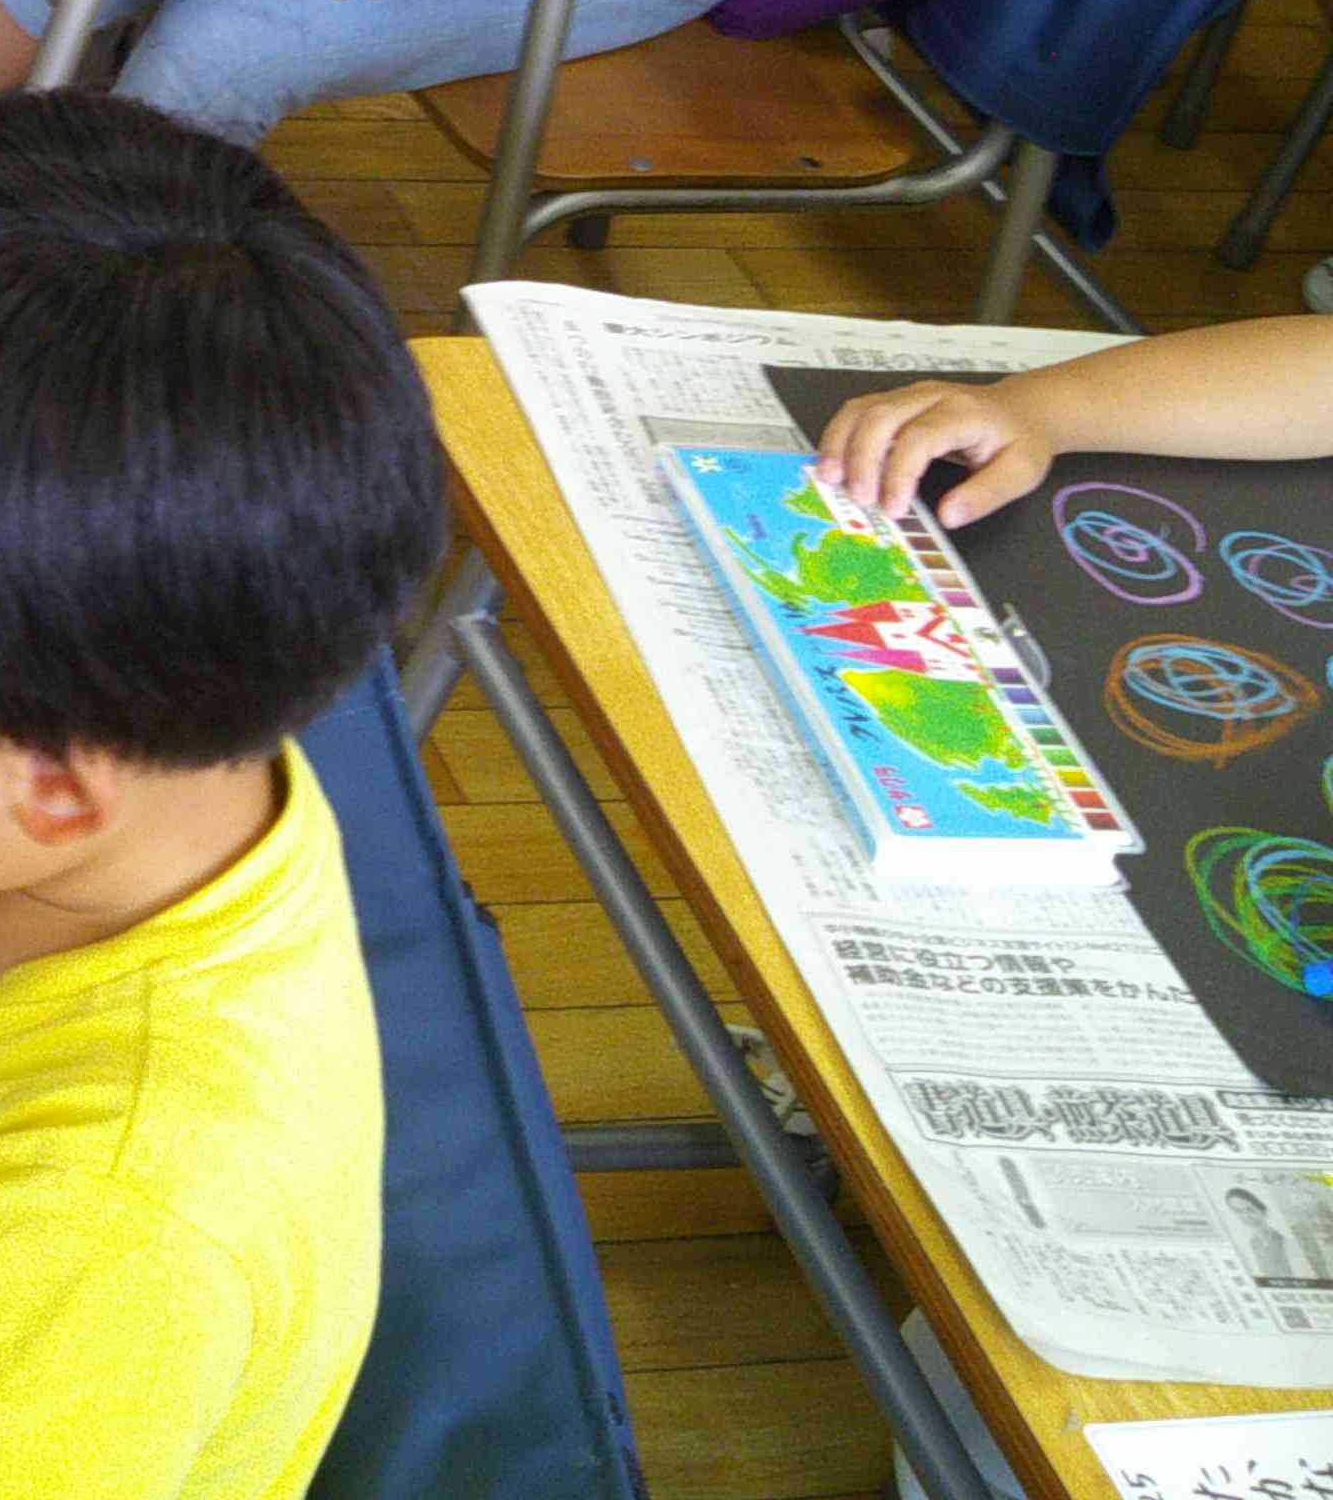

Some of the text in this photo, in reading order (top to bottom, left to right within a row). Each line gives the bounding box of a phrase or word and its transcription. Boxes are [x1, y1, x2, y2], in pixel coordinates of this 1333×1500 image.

[833, 938, 1077, 975] 経営に役立つ情報や
